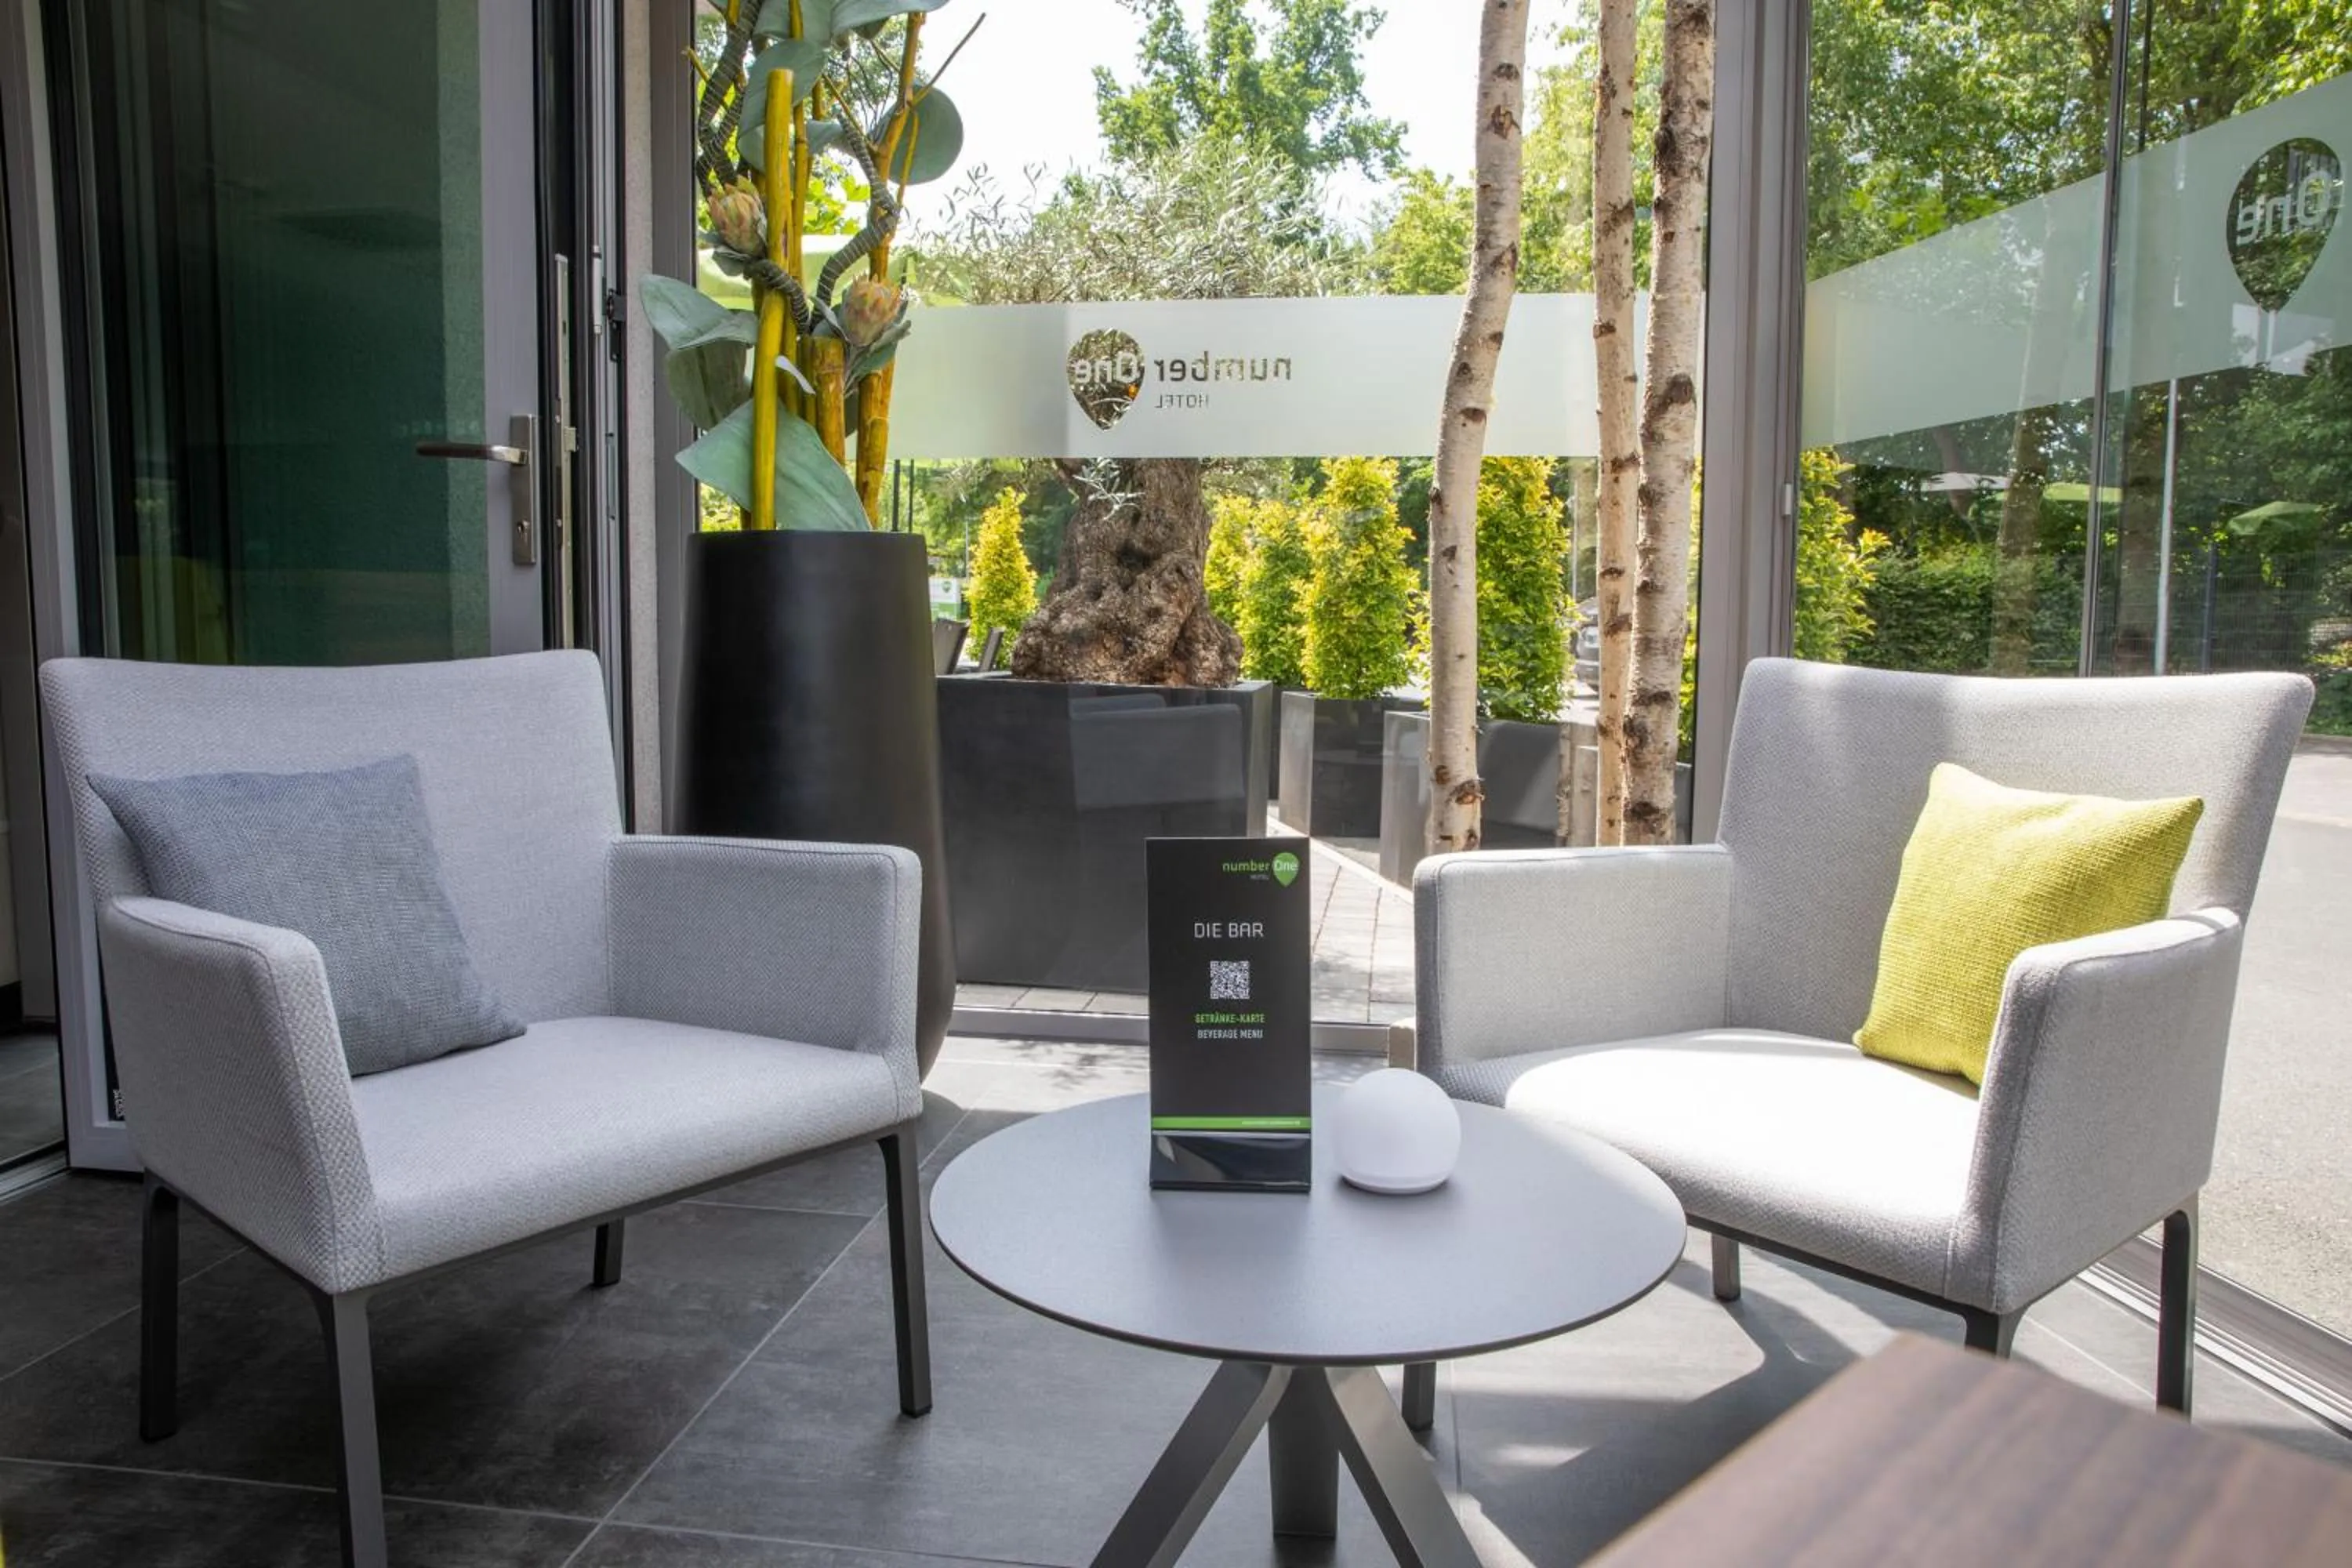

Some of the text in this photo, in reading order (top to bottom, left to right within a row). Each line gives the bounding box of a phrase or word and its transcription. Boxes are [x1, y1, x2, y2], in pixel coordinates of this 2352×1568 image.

[1222, 859, 1299, 872] number One
[1194, 923, 1265, 938] DIE BAR
[1197, 1029, 1264, 1039] BEVERAGE MENU
